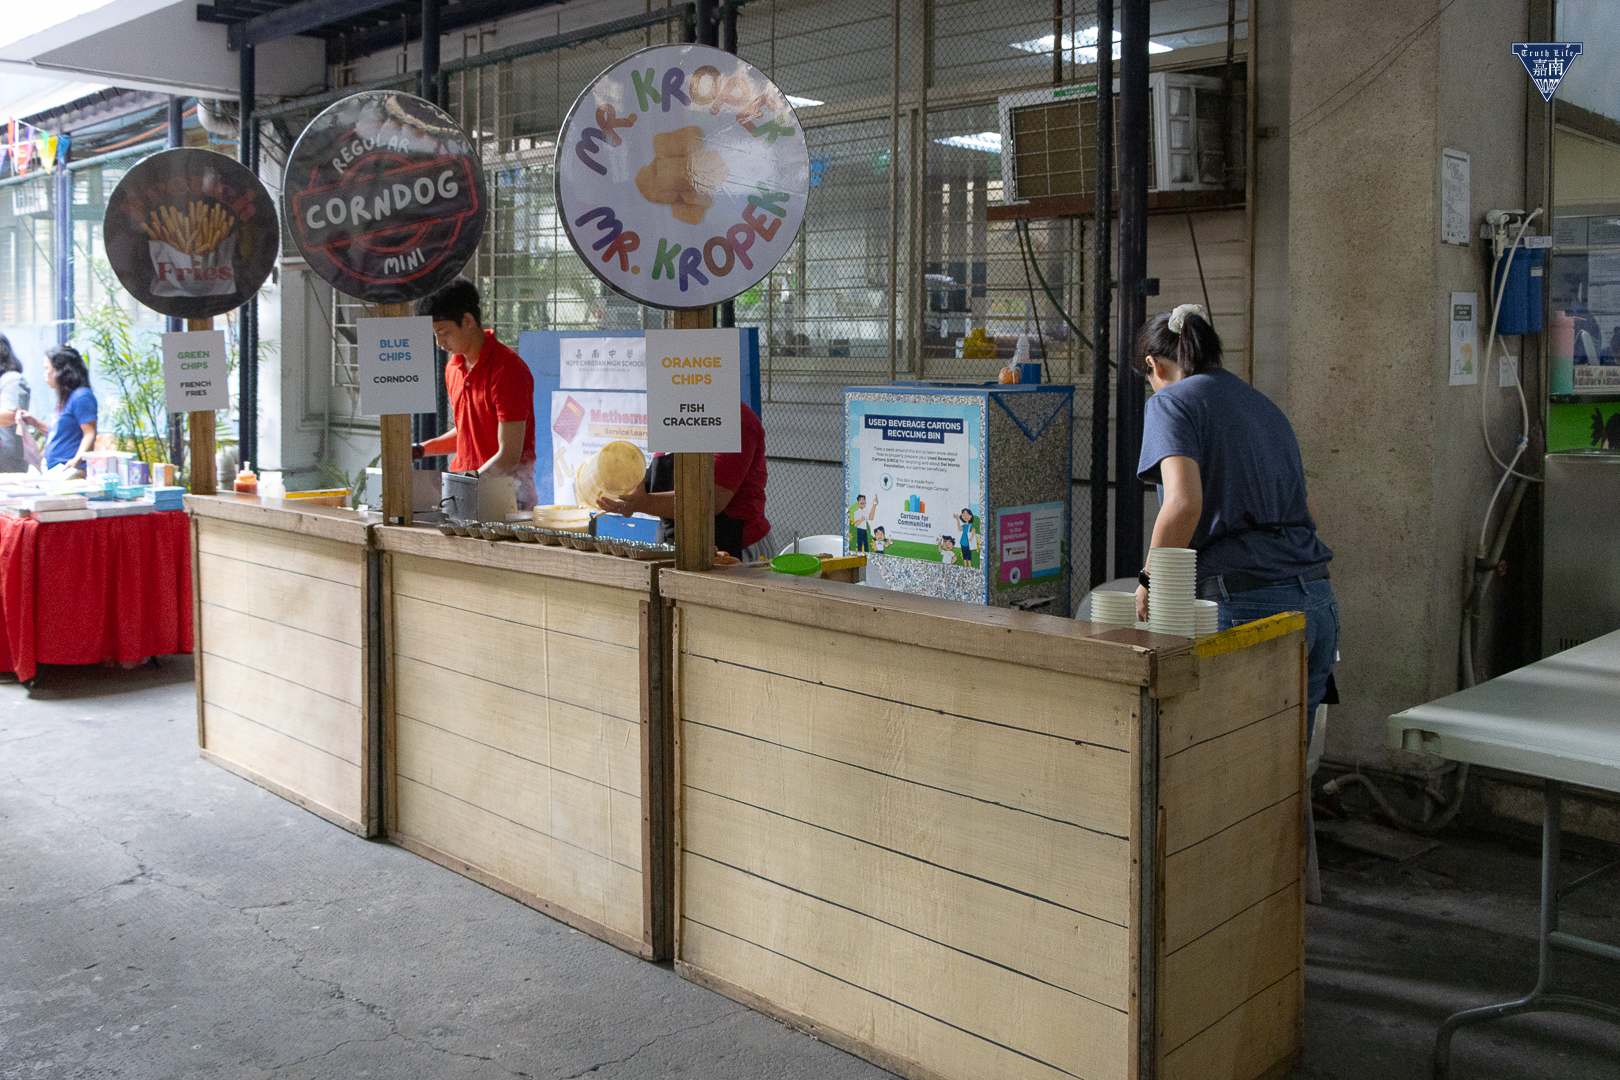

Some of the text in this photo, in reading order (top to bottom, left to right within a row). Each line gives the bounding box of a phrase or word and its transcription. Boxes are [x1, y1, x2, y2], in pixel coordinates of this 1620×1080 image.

[575, 65, 796, 176] MR. KROPEK
[333, 134, 410, 174] REGULAR
[306, 170, 458, 230] CORNDOG
[575, 181, 790, 292] MR. KROPEK
[384, 247, 425, 275] MINI
[157, 261, 233, 282] Fries
[380, 339, 410, 348] BLUE
[178, 351, 210, 359] GREEN
[379, 352, 411, 361] CHIPS
[181, 362, 208, 370] CHIPS
[662, 357, 722, 368] ORANGE
[374, 375, 419, 383] CORNDOG
[672, 374, 712, 385] CHIPS
[680, 404, 705, 413] FISH
[663, 417, 722, 426] CRACKERS
[868, 418, 961, 430] USED BEVERAGE CARTONS
[888, 430, 926, 439] RECYCLING
[898, 519, 932, 528] Communities
